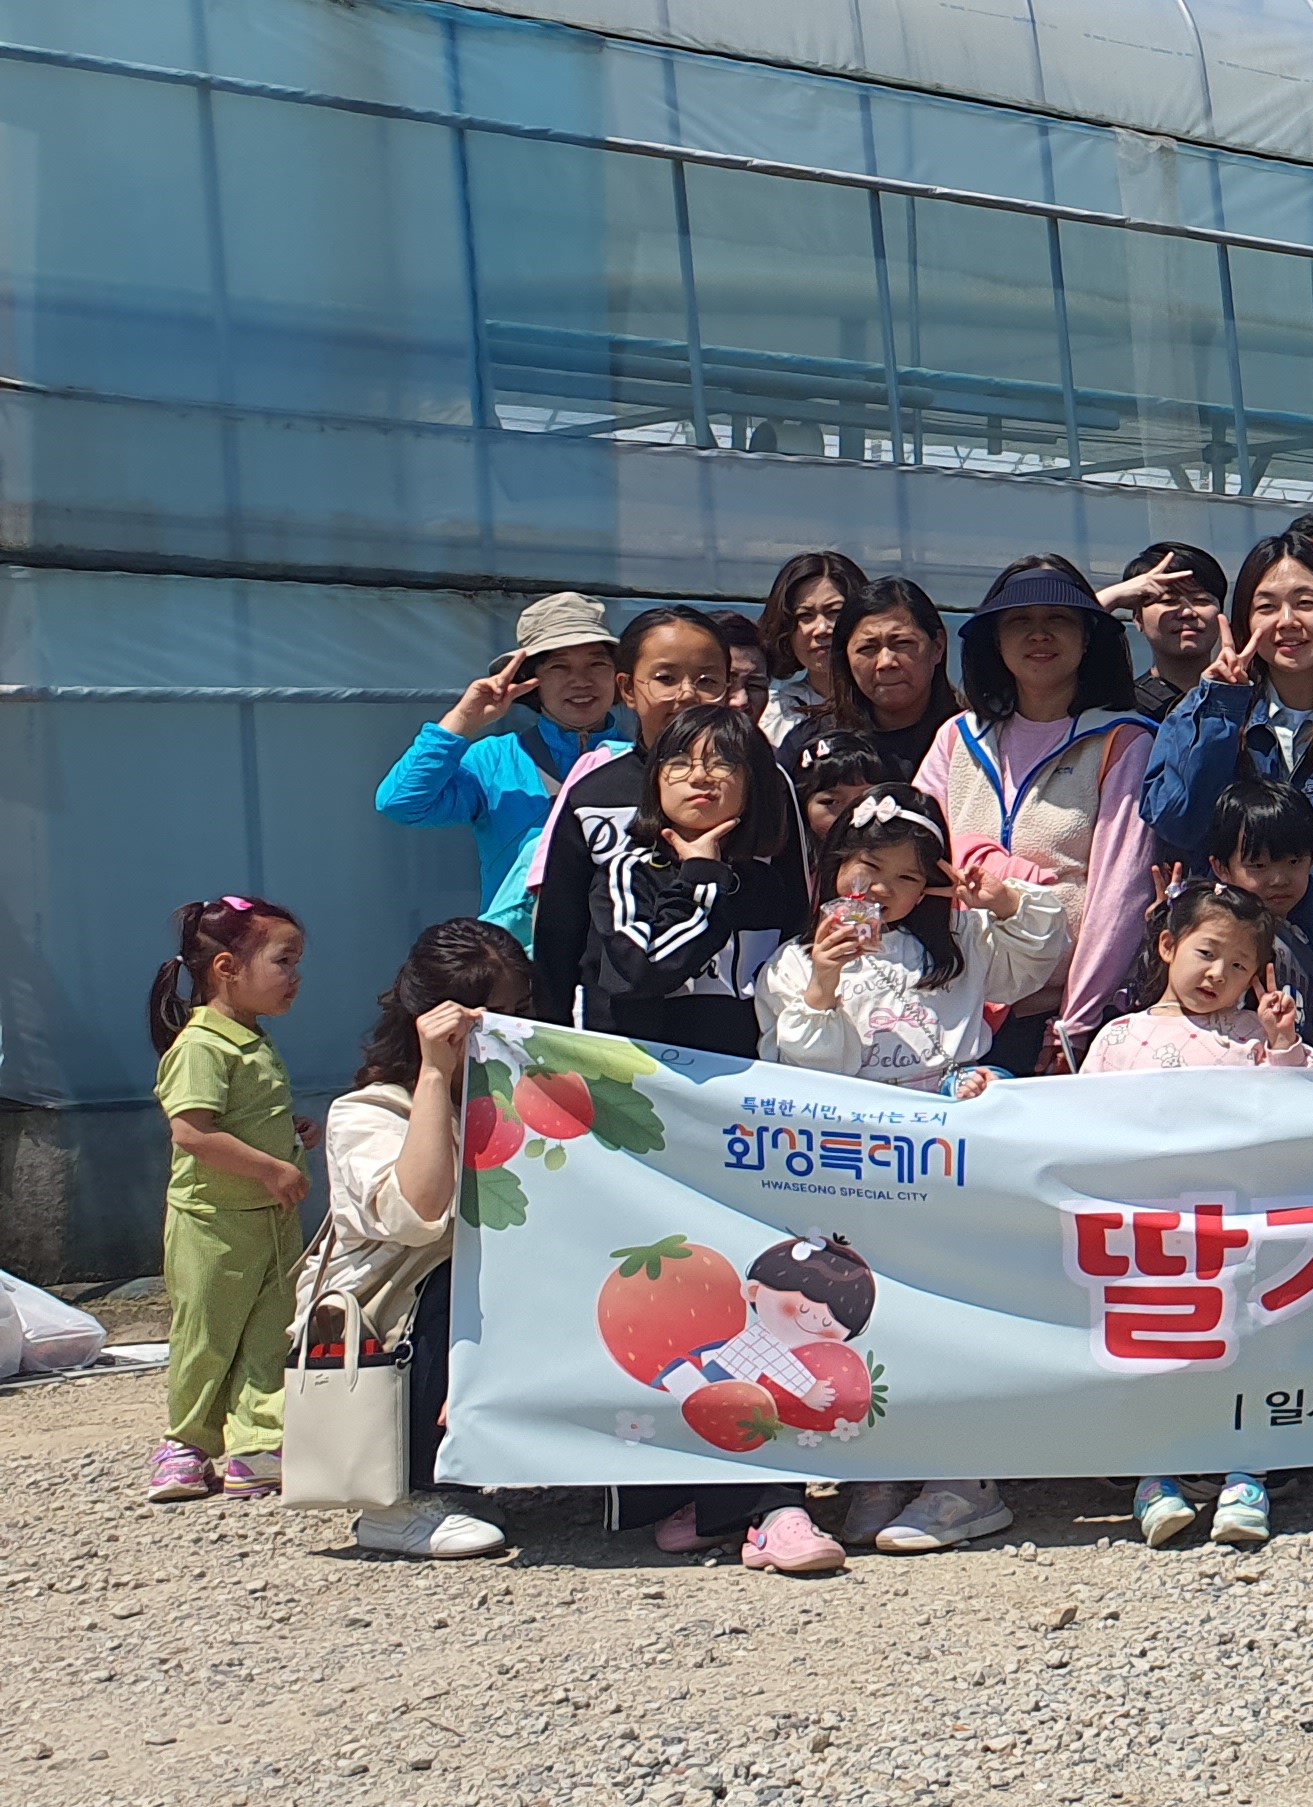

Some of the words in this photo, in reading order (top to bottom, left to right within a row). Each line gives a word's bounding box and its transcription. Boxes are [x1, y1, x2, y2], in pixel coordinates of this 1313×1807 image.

[741, 1097, 796, 1118] 특별한
[801, 1102, 842, 1123] 시민,
[909, 1111, 948, 1126] 도시
[722, 1123, 966, 1187] 화성특례시
[761, 1179, 836, 1196] HWASEONG
[840, 1187, 894, 1200] SPECIAL
[897, 1191, 928, 1202] CITY
